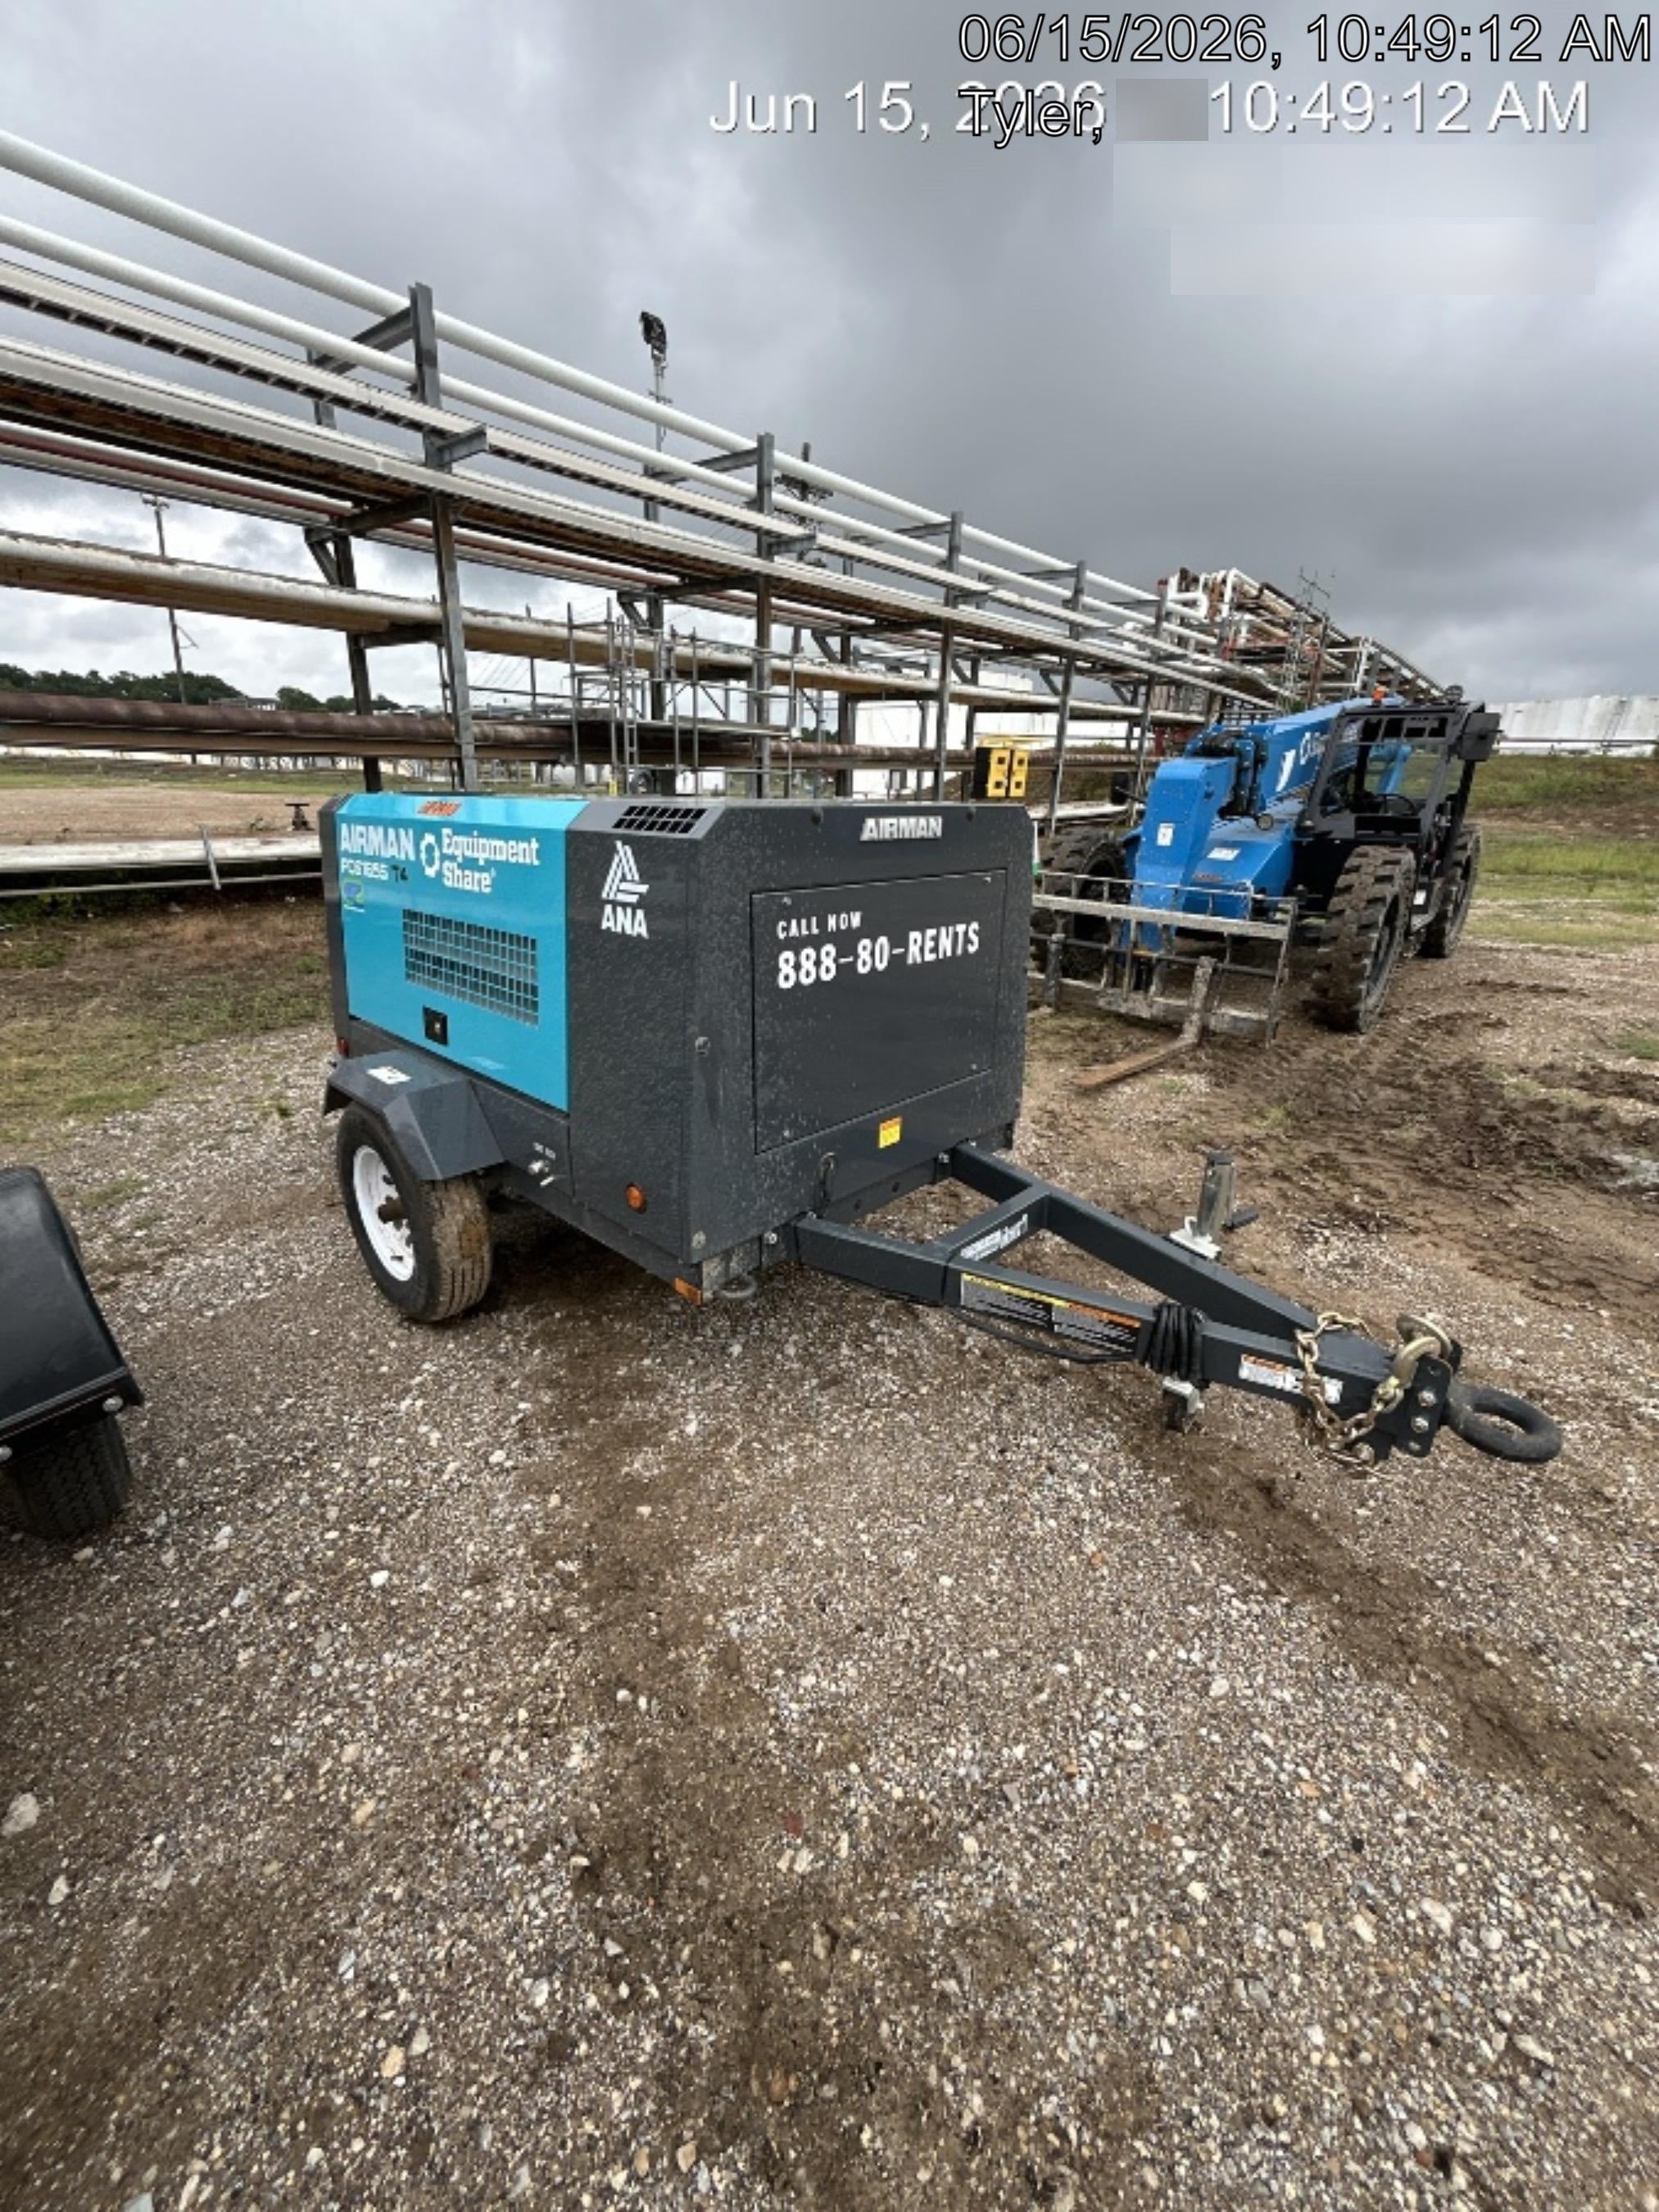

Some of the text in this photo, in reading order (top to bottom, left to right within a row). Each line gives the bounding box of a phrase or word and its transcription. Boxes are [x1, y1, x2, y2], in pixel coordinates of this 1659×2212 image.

[340, 823, 415, 862] AIRMAN
[859, 815, 942, 841] AIRMAN
[442, 827, 540, 866] Equipment
[442, 860, 492, 894] Share
[601, 904, 650, 940] ANA
[777, 910, 863, 941] CALL NOW
[777, 920, 980, 990] 888-80-RENTS
